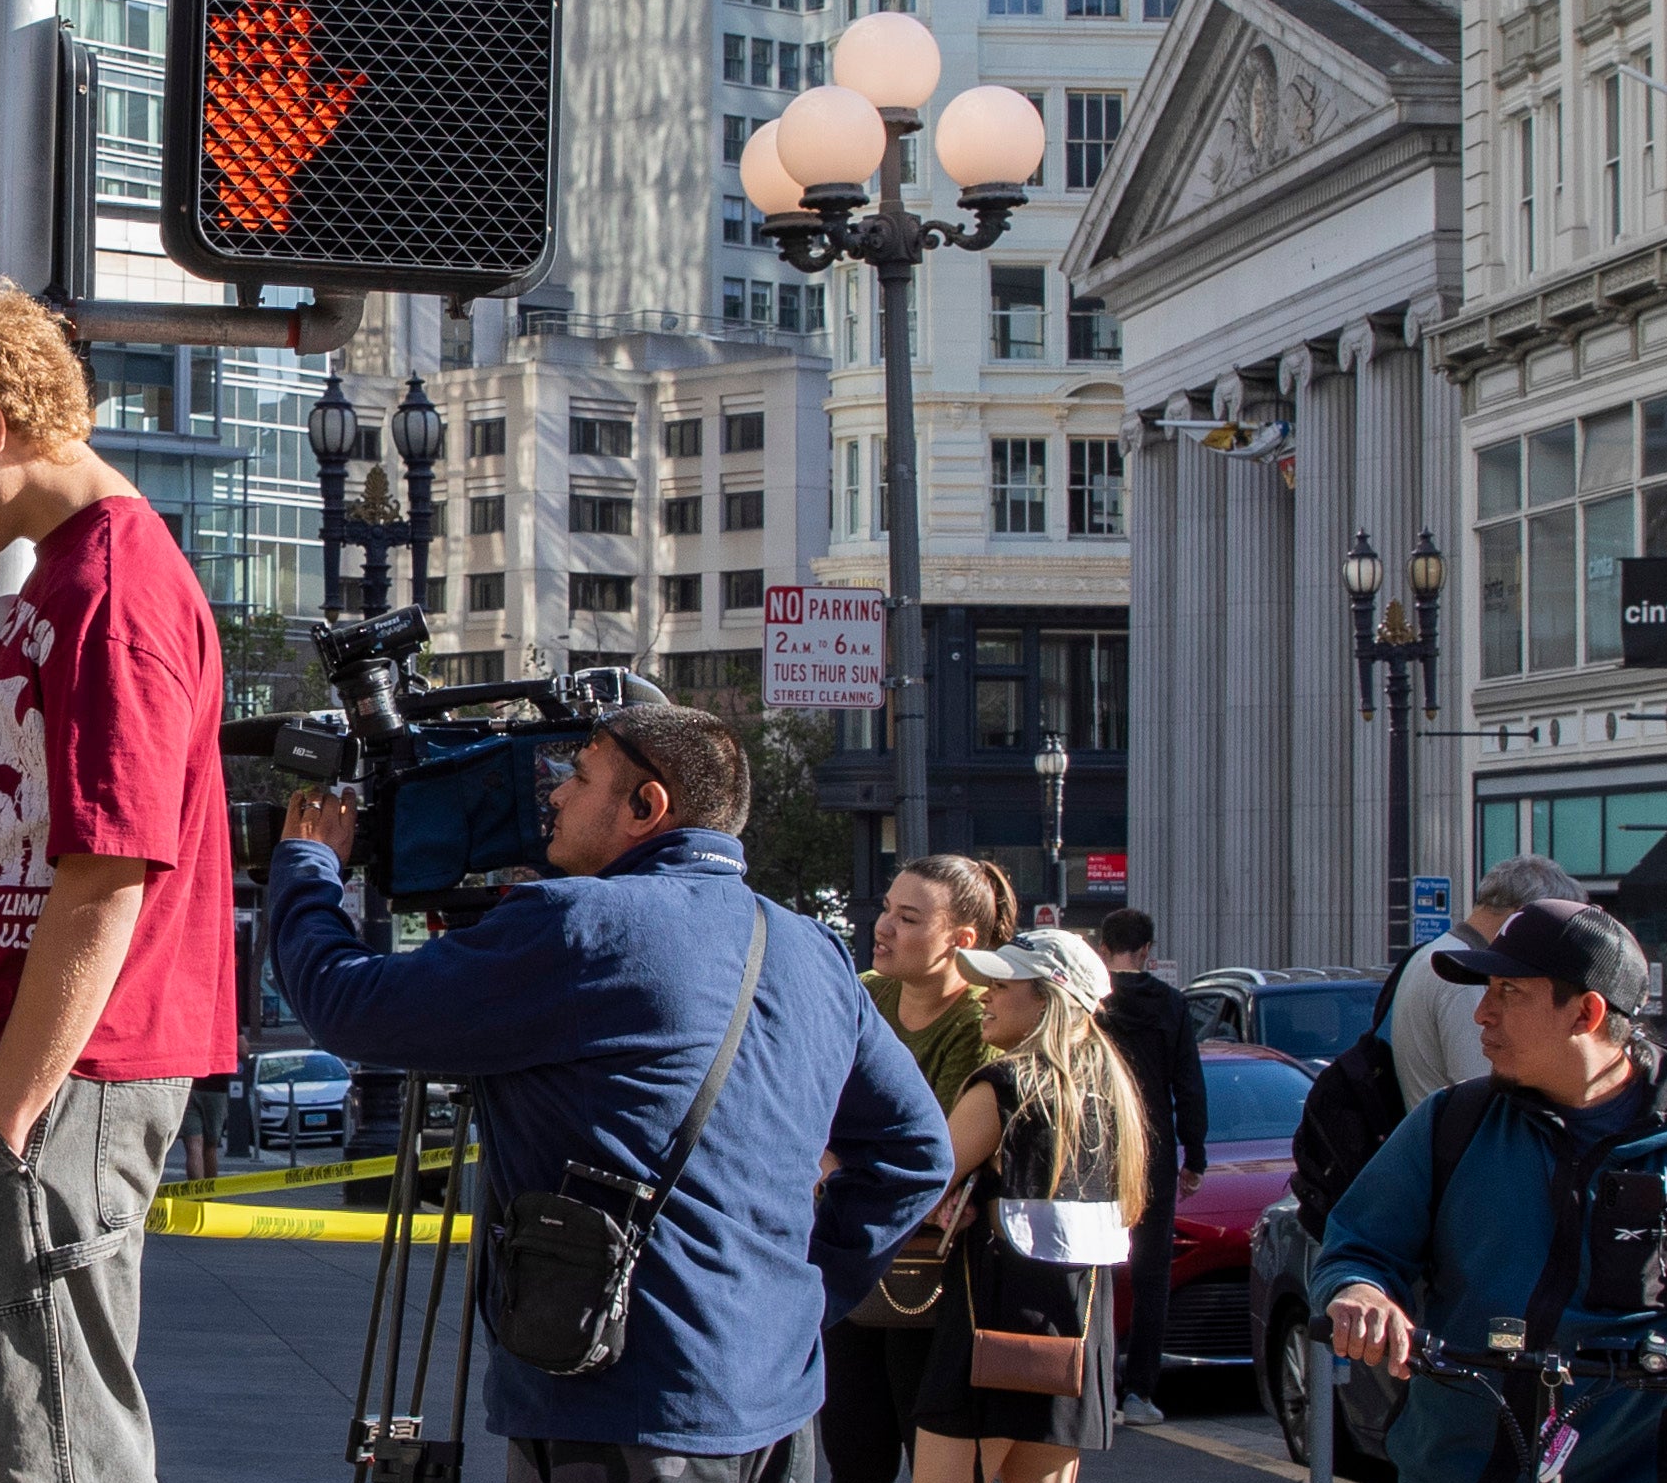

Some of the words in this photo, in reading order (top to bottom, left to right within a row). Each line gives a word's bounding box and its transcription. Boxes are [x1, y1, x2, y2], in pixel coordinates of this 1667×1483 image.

[769, 591, 801, 621] NO
[809, 598, 881, 622] PARKING
[775, 631, 788, 653] 2
[791, 642, 815, 655] A.M.
[834, 633, 847, 655] 6
[850, 643, 875, 656] A.M.
[774, 663, 807, 683] TUES
[811, 664, 847, 684] THUR
[851, 665, 879, 685] SUN
[773, 689, 815, 702] STREET
[818, 690, 874, 704] CLEANING
